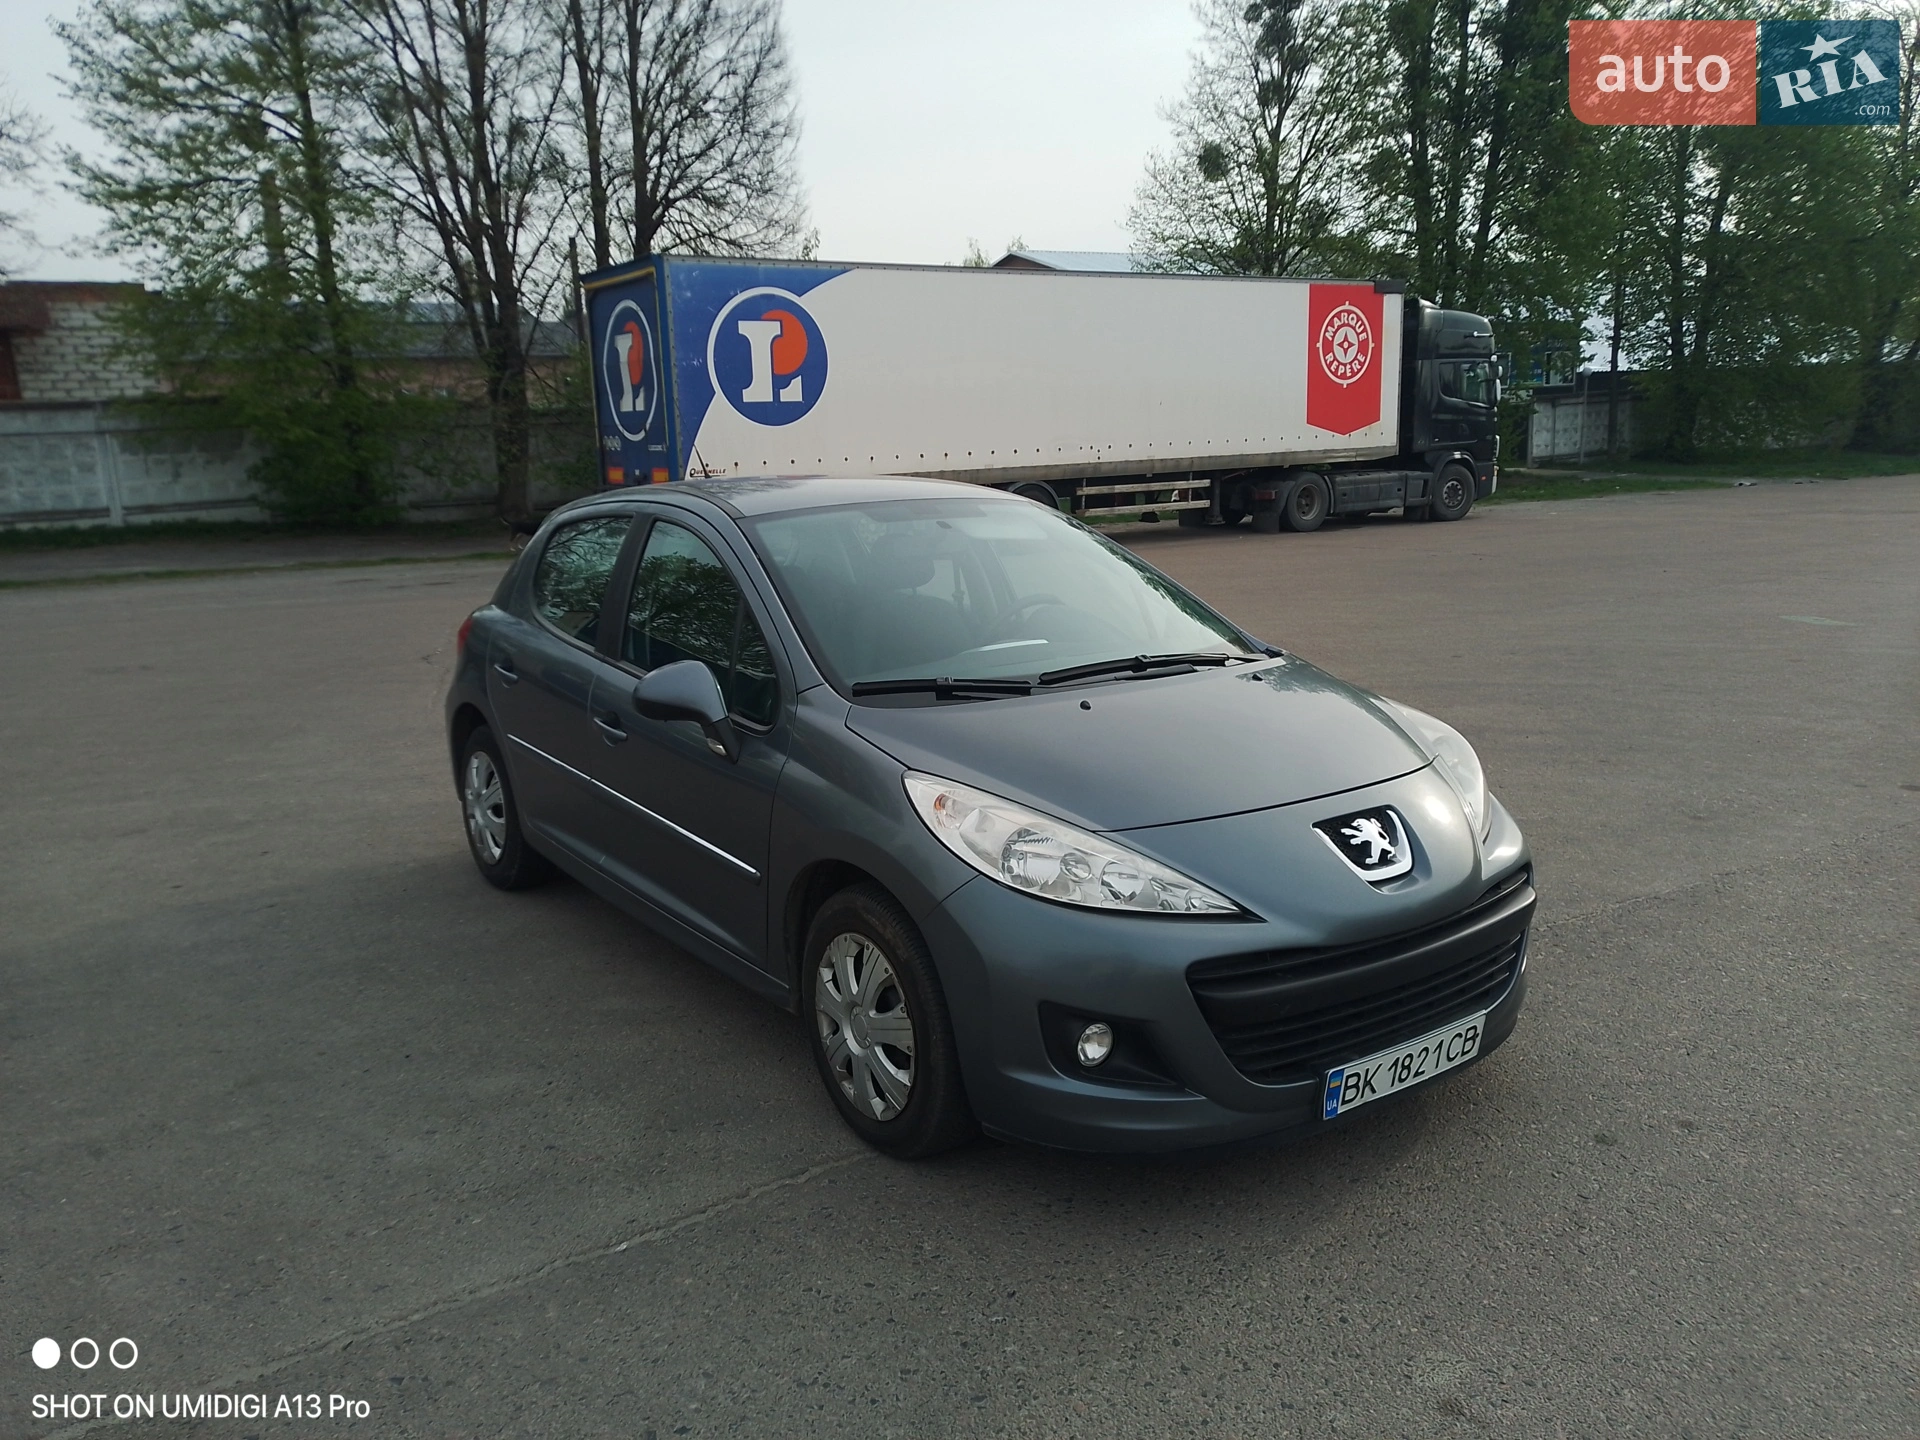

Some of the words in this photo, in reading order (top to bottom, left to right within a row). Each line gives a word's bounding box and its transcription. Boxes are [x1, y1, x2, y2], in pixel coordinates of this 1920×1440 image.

[1325, 312, 1367, 342] MARQUE
[1324, 352, 1366, 377] REPÈRE
[1387, 1039, 1445, 1087] 1821
[1327, 1099, 1337, 1111] UA
